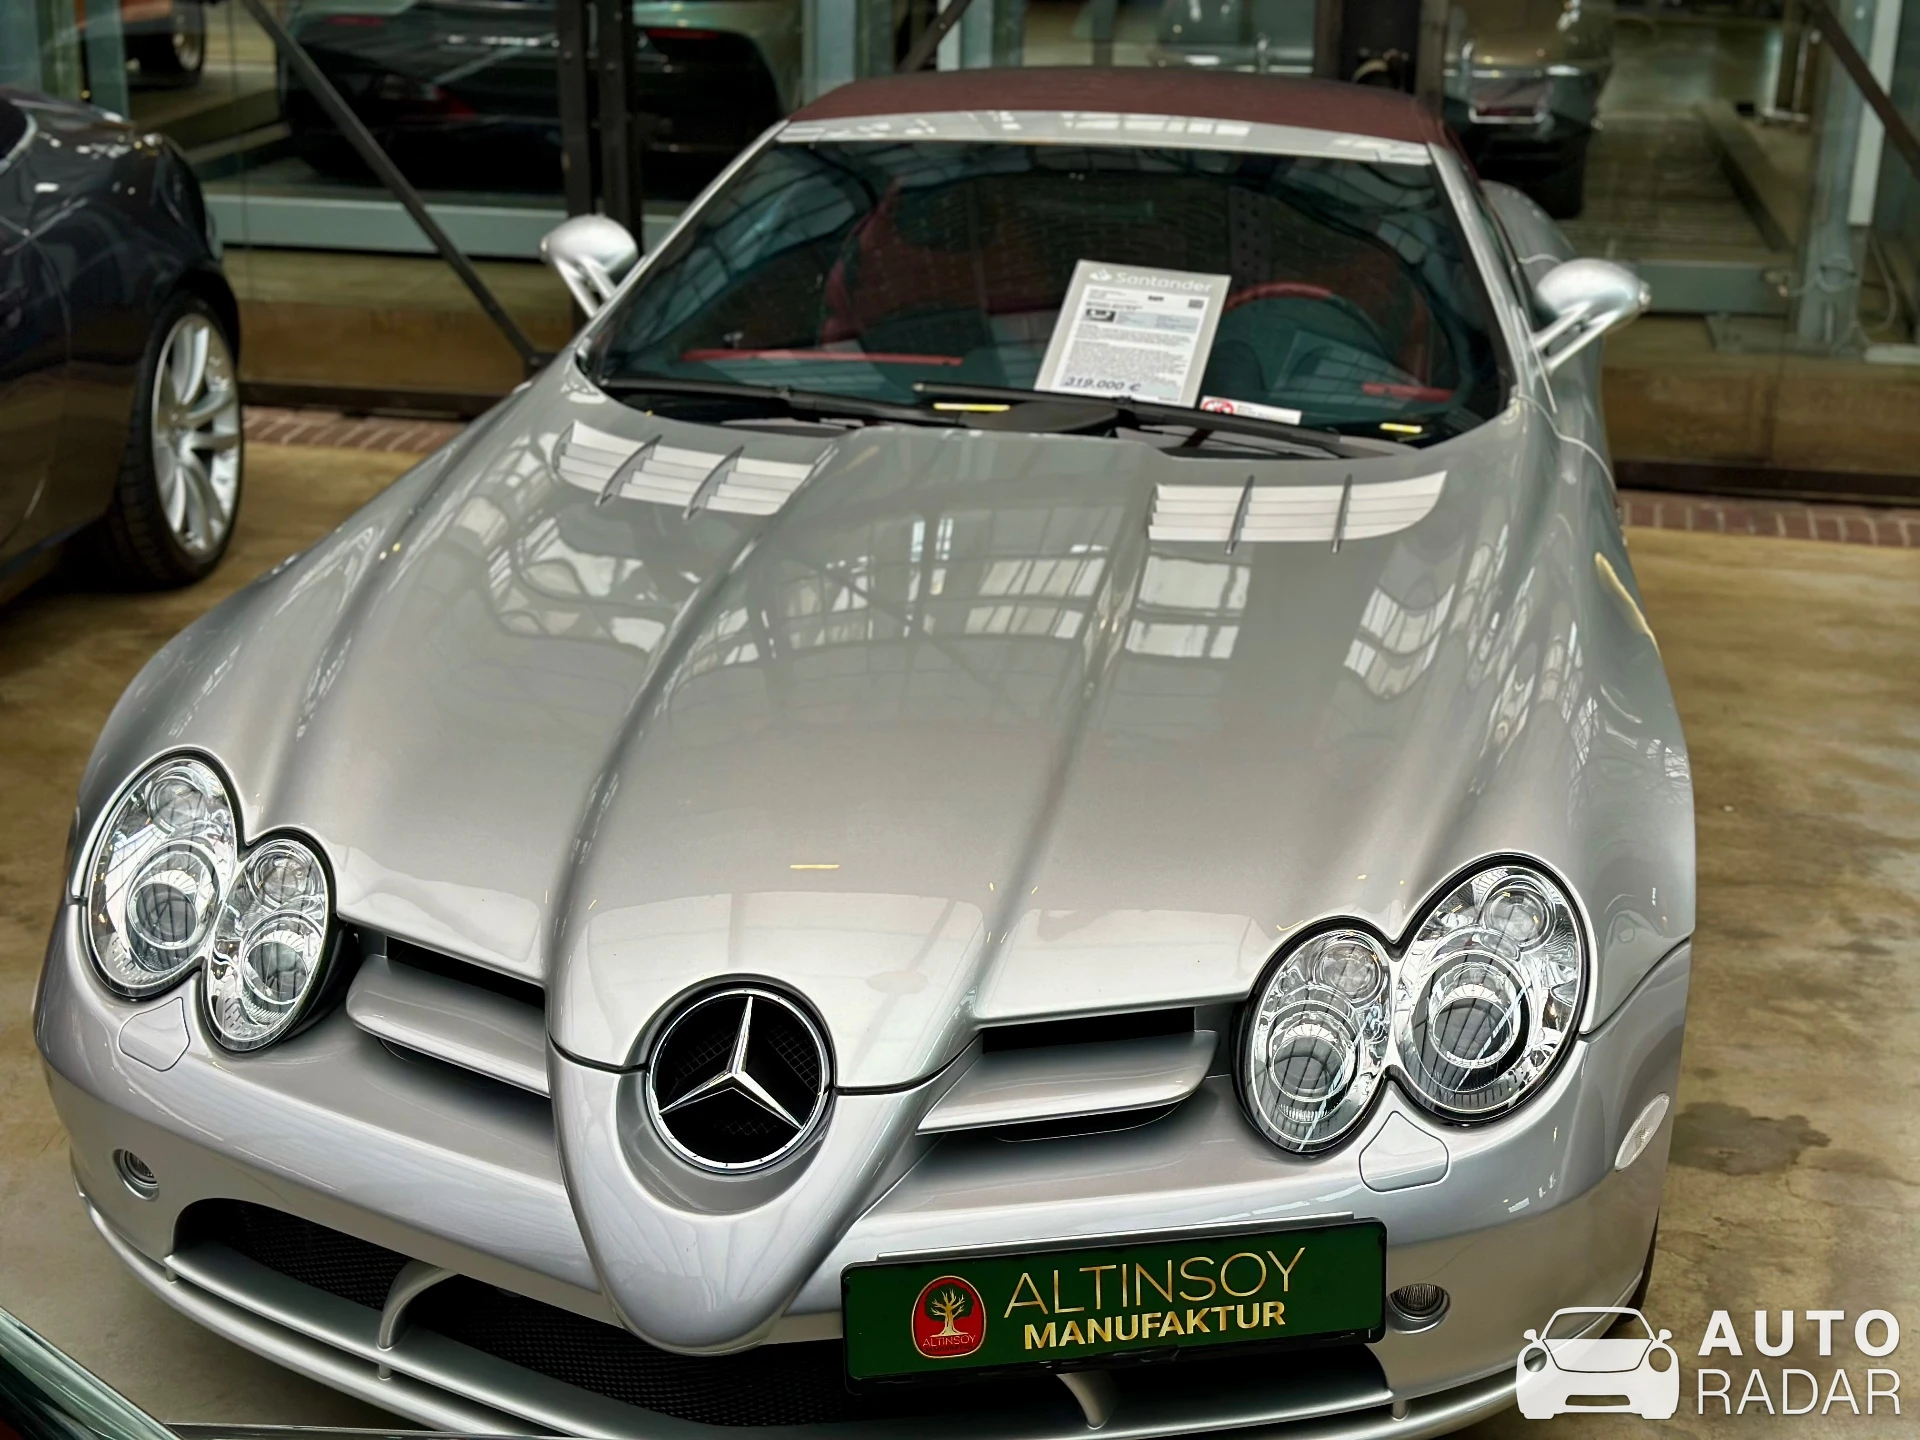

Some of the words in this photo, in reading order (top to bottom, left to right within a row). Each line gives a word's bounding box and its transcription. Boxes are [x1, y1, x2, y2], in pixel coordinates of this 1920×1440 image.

[1115, 272, 1213, 292] Santander
[1064, 377, 1125, 391] 319.000
[1129, 382, 1142, 392] €
[1004, 1247, 1306, 1318] ALTINSOY
[1024, 1301, 1286, 1350] MANUFAKTUR
[922, 1335, 976, 1347] ALTINSOY
